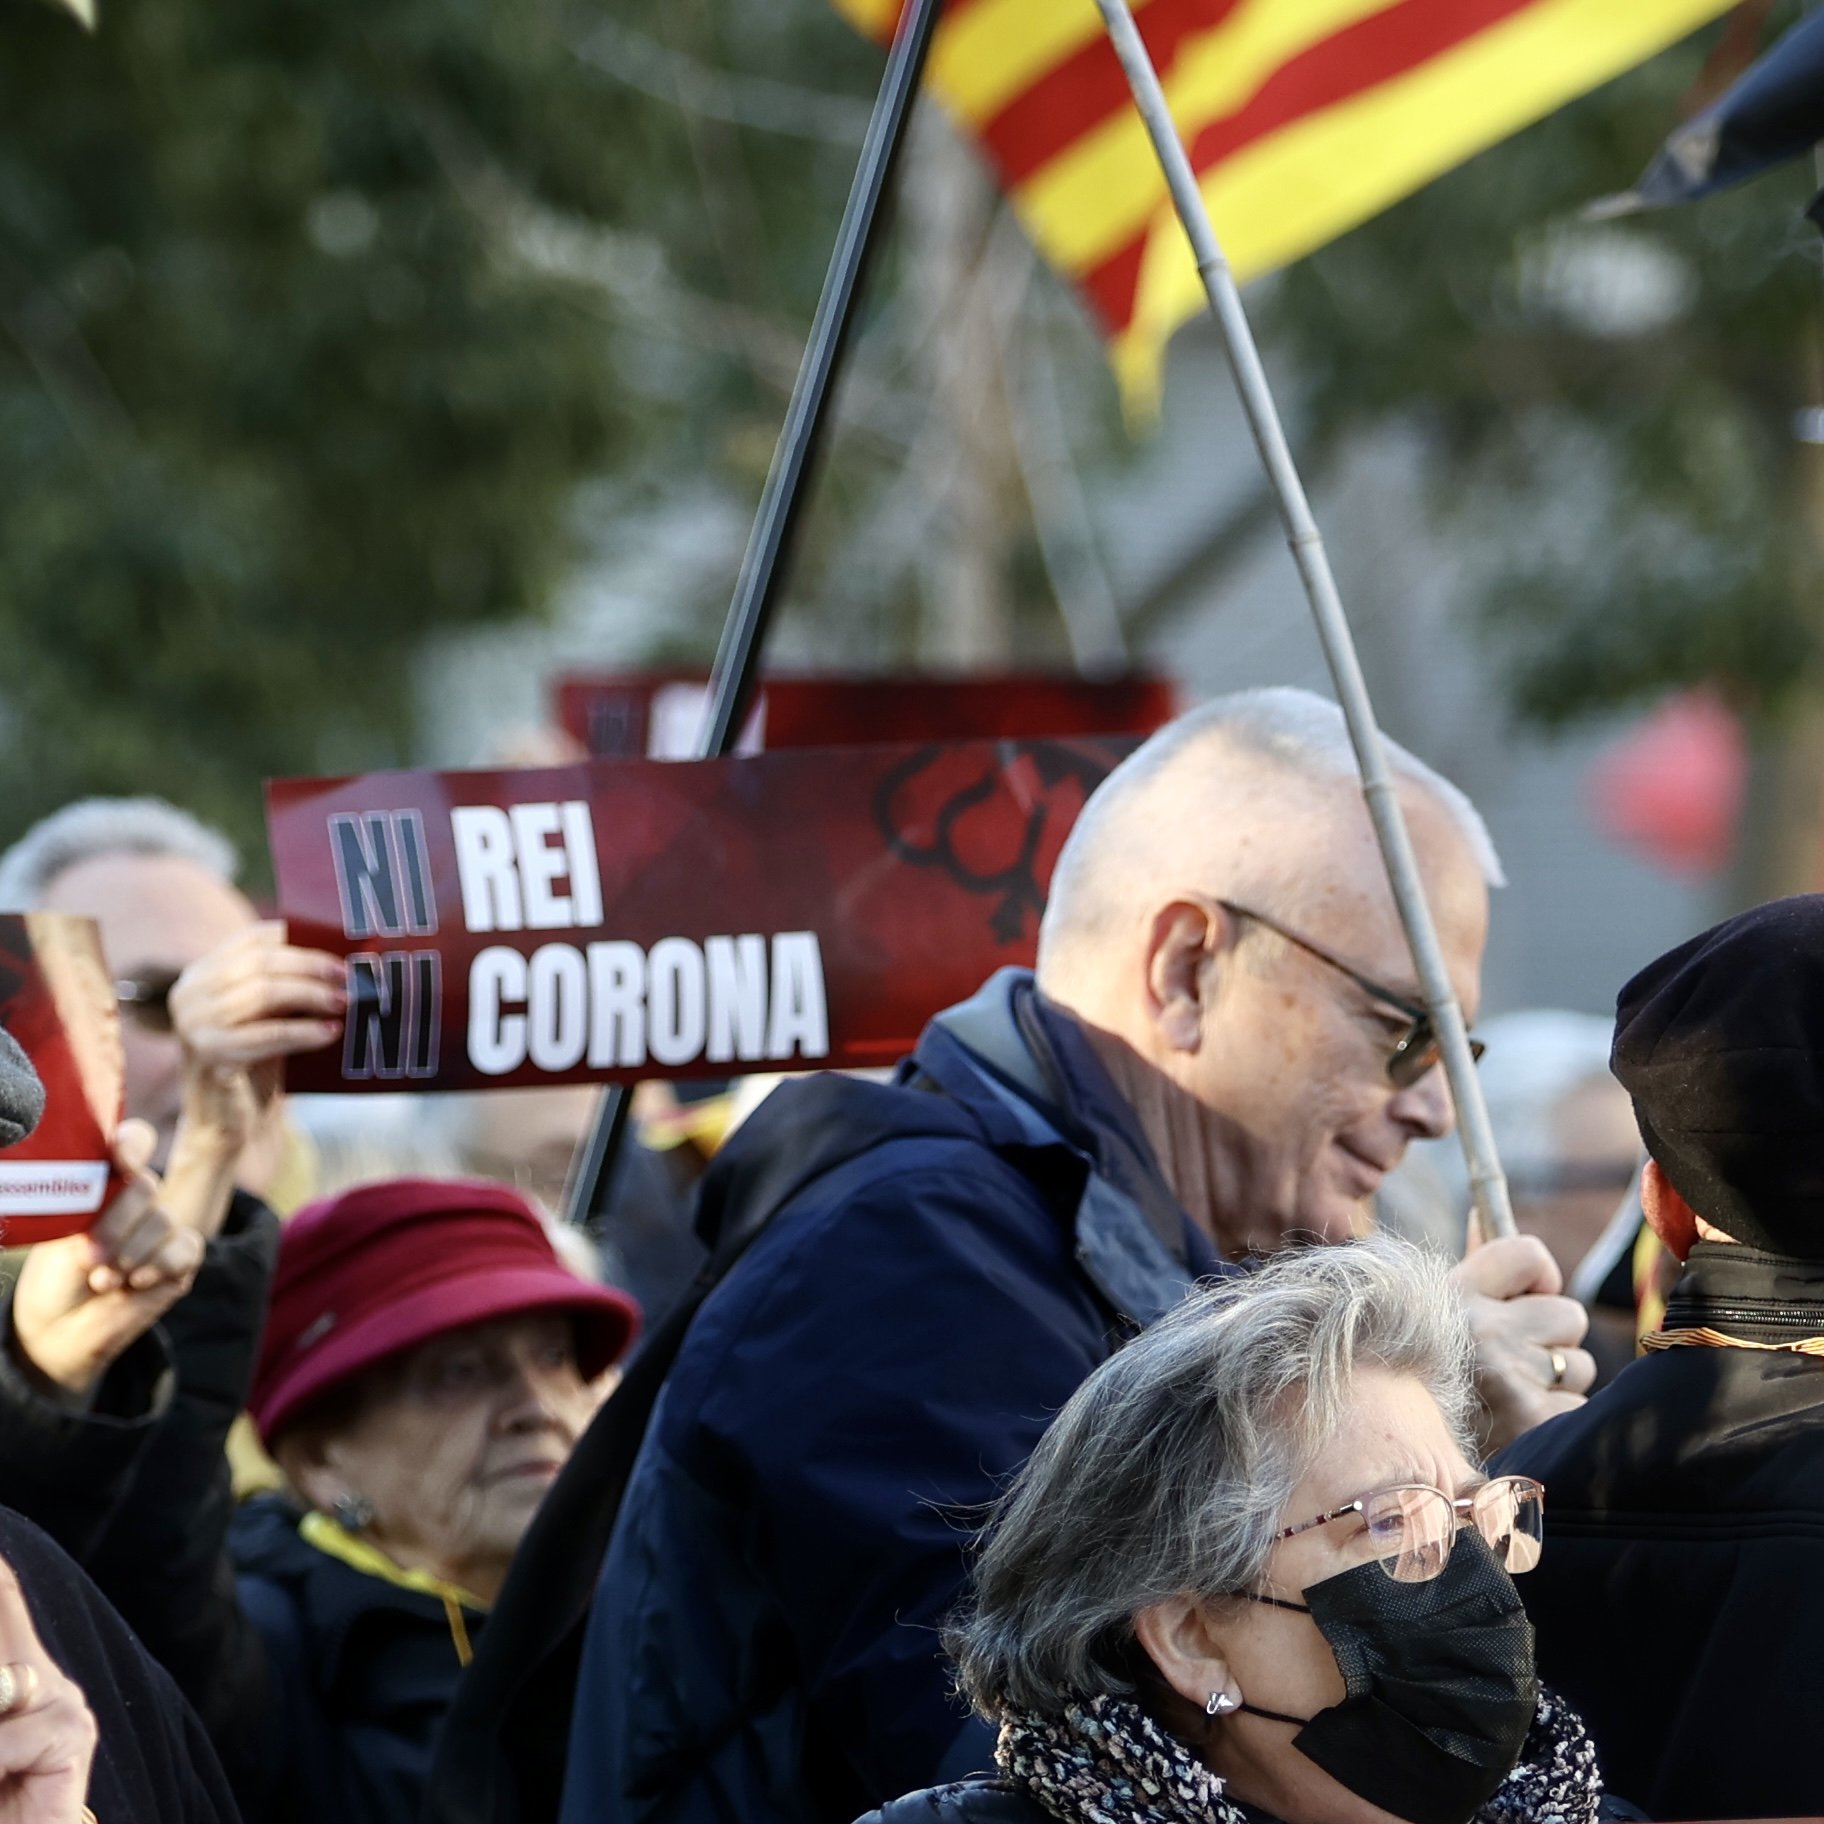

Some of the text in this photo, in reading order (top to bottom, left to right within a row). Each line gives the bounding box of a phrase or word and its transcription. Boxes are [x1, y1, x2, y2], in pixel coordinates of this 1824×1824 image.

[328, 801, 604, 939] NI REI
[341, 930, 830, 1079] NI CORONA
